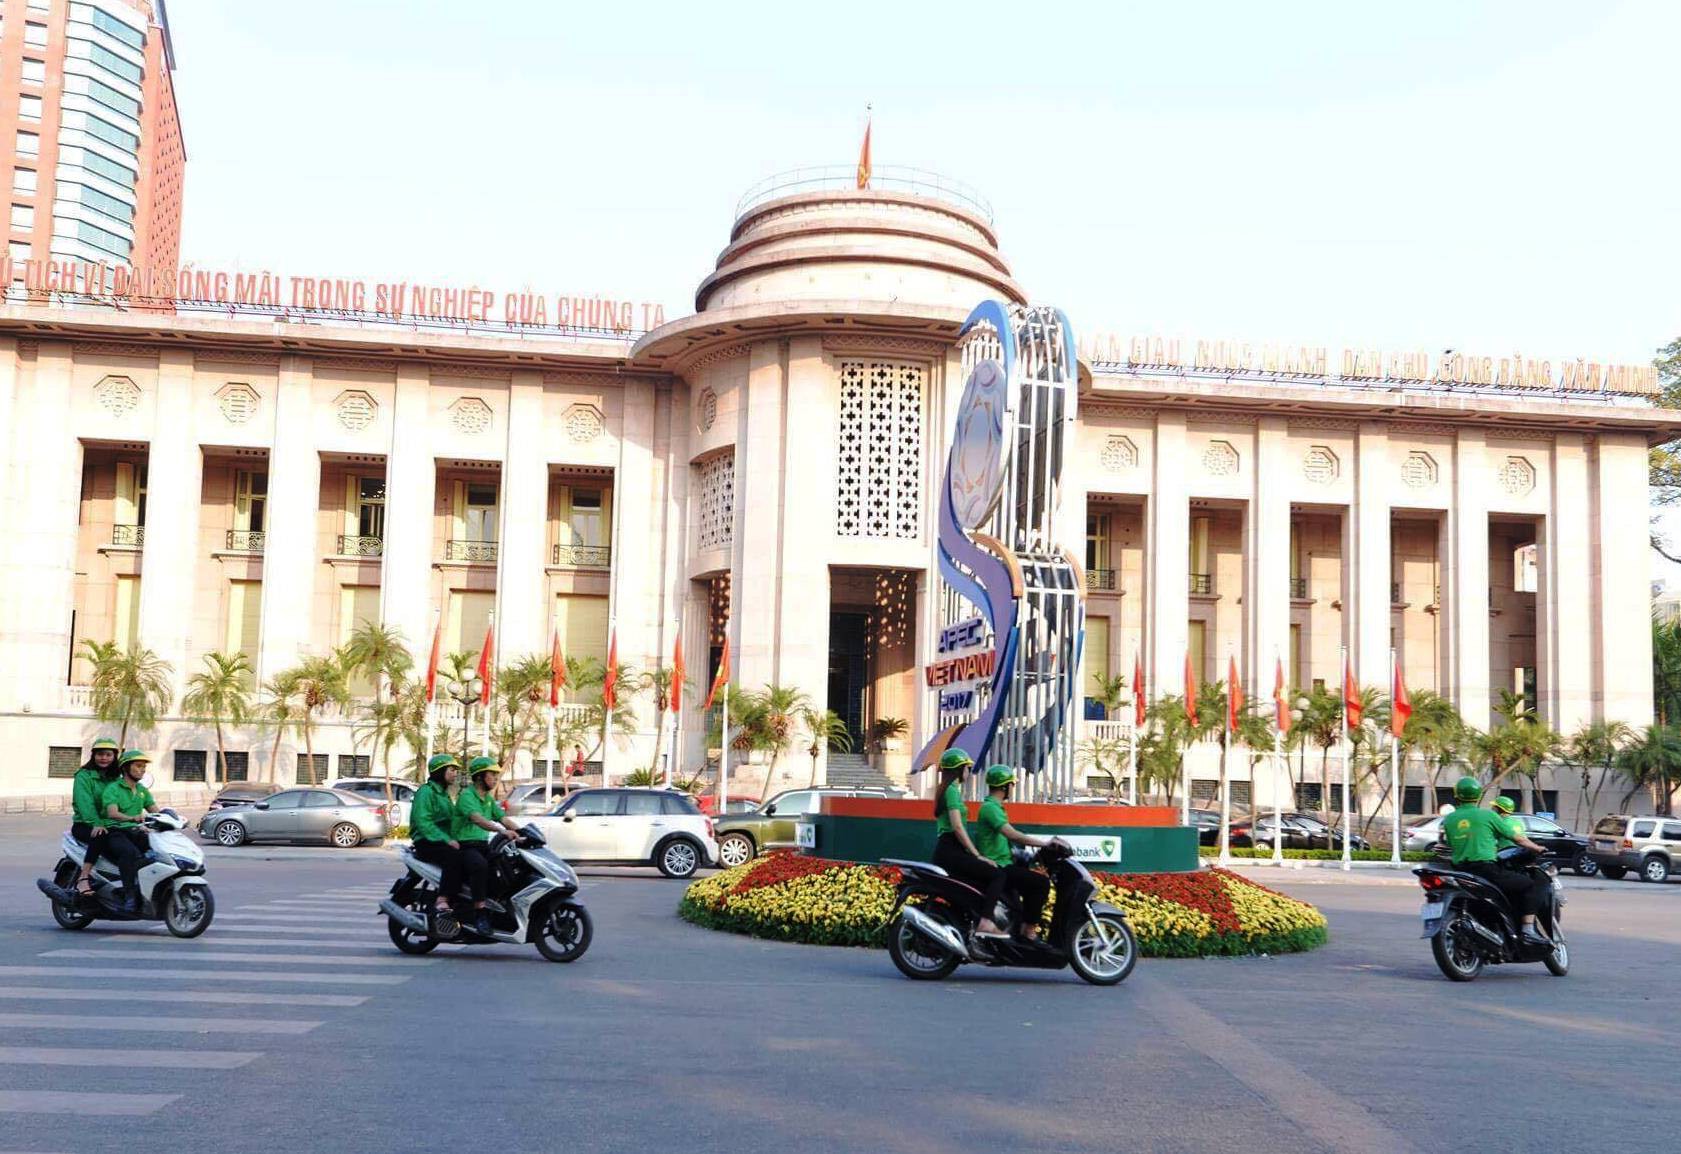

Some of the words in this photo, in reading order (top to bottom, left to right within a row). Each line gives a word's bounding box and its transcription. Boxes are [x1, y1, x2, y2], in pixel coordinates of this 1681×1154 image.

[234, 269, 281, 305] MÃI
[290, 277, 365, 311] TRONG
[557, 294, 632, 331] CHÚNG
[641, 302, 665, 331] TA
[938, 618, 983, 653] APEC
[926, 650, 996, 687] VIETNAM
